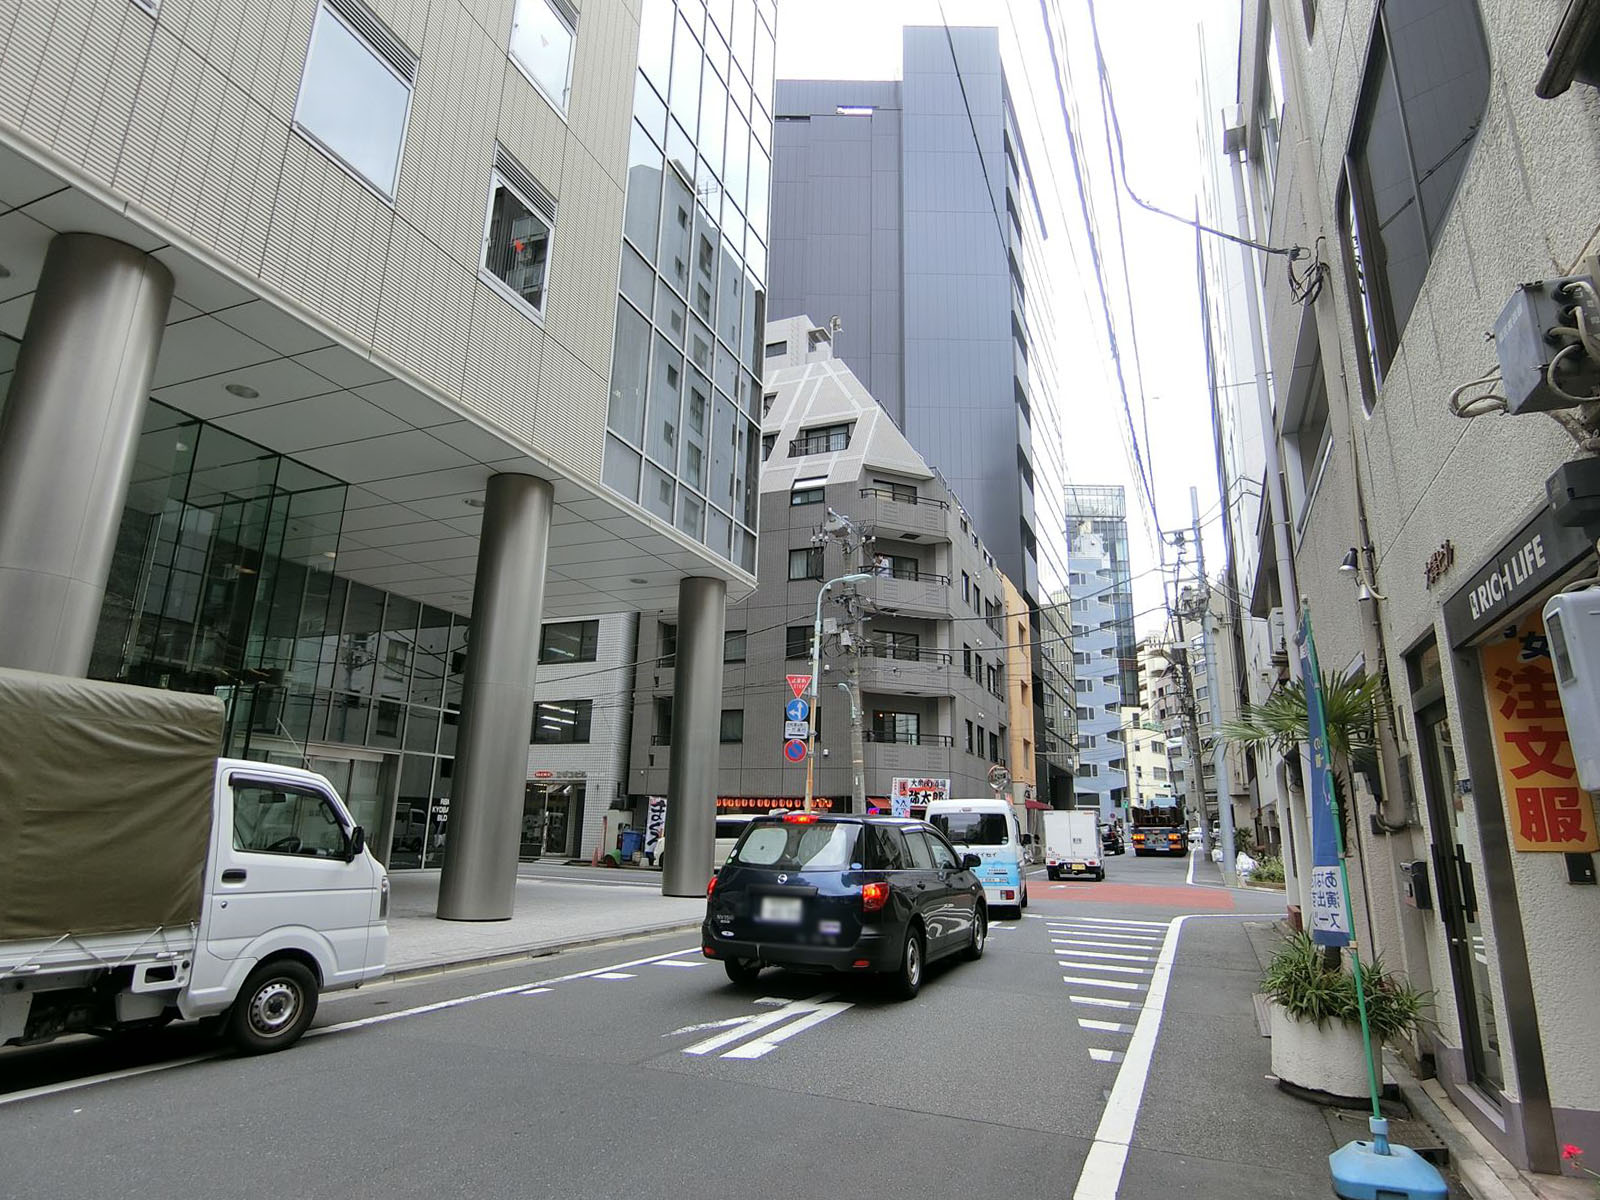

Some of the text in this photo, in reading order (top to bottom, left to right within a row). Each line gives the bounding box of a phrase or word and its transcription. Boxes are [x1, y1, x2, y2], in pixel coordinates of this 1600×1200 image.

[1477, 534, 1546, 613] RICH LIFE
[1495, 664, 1588, 843] 注文服
